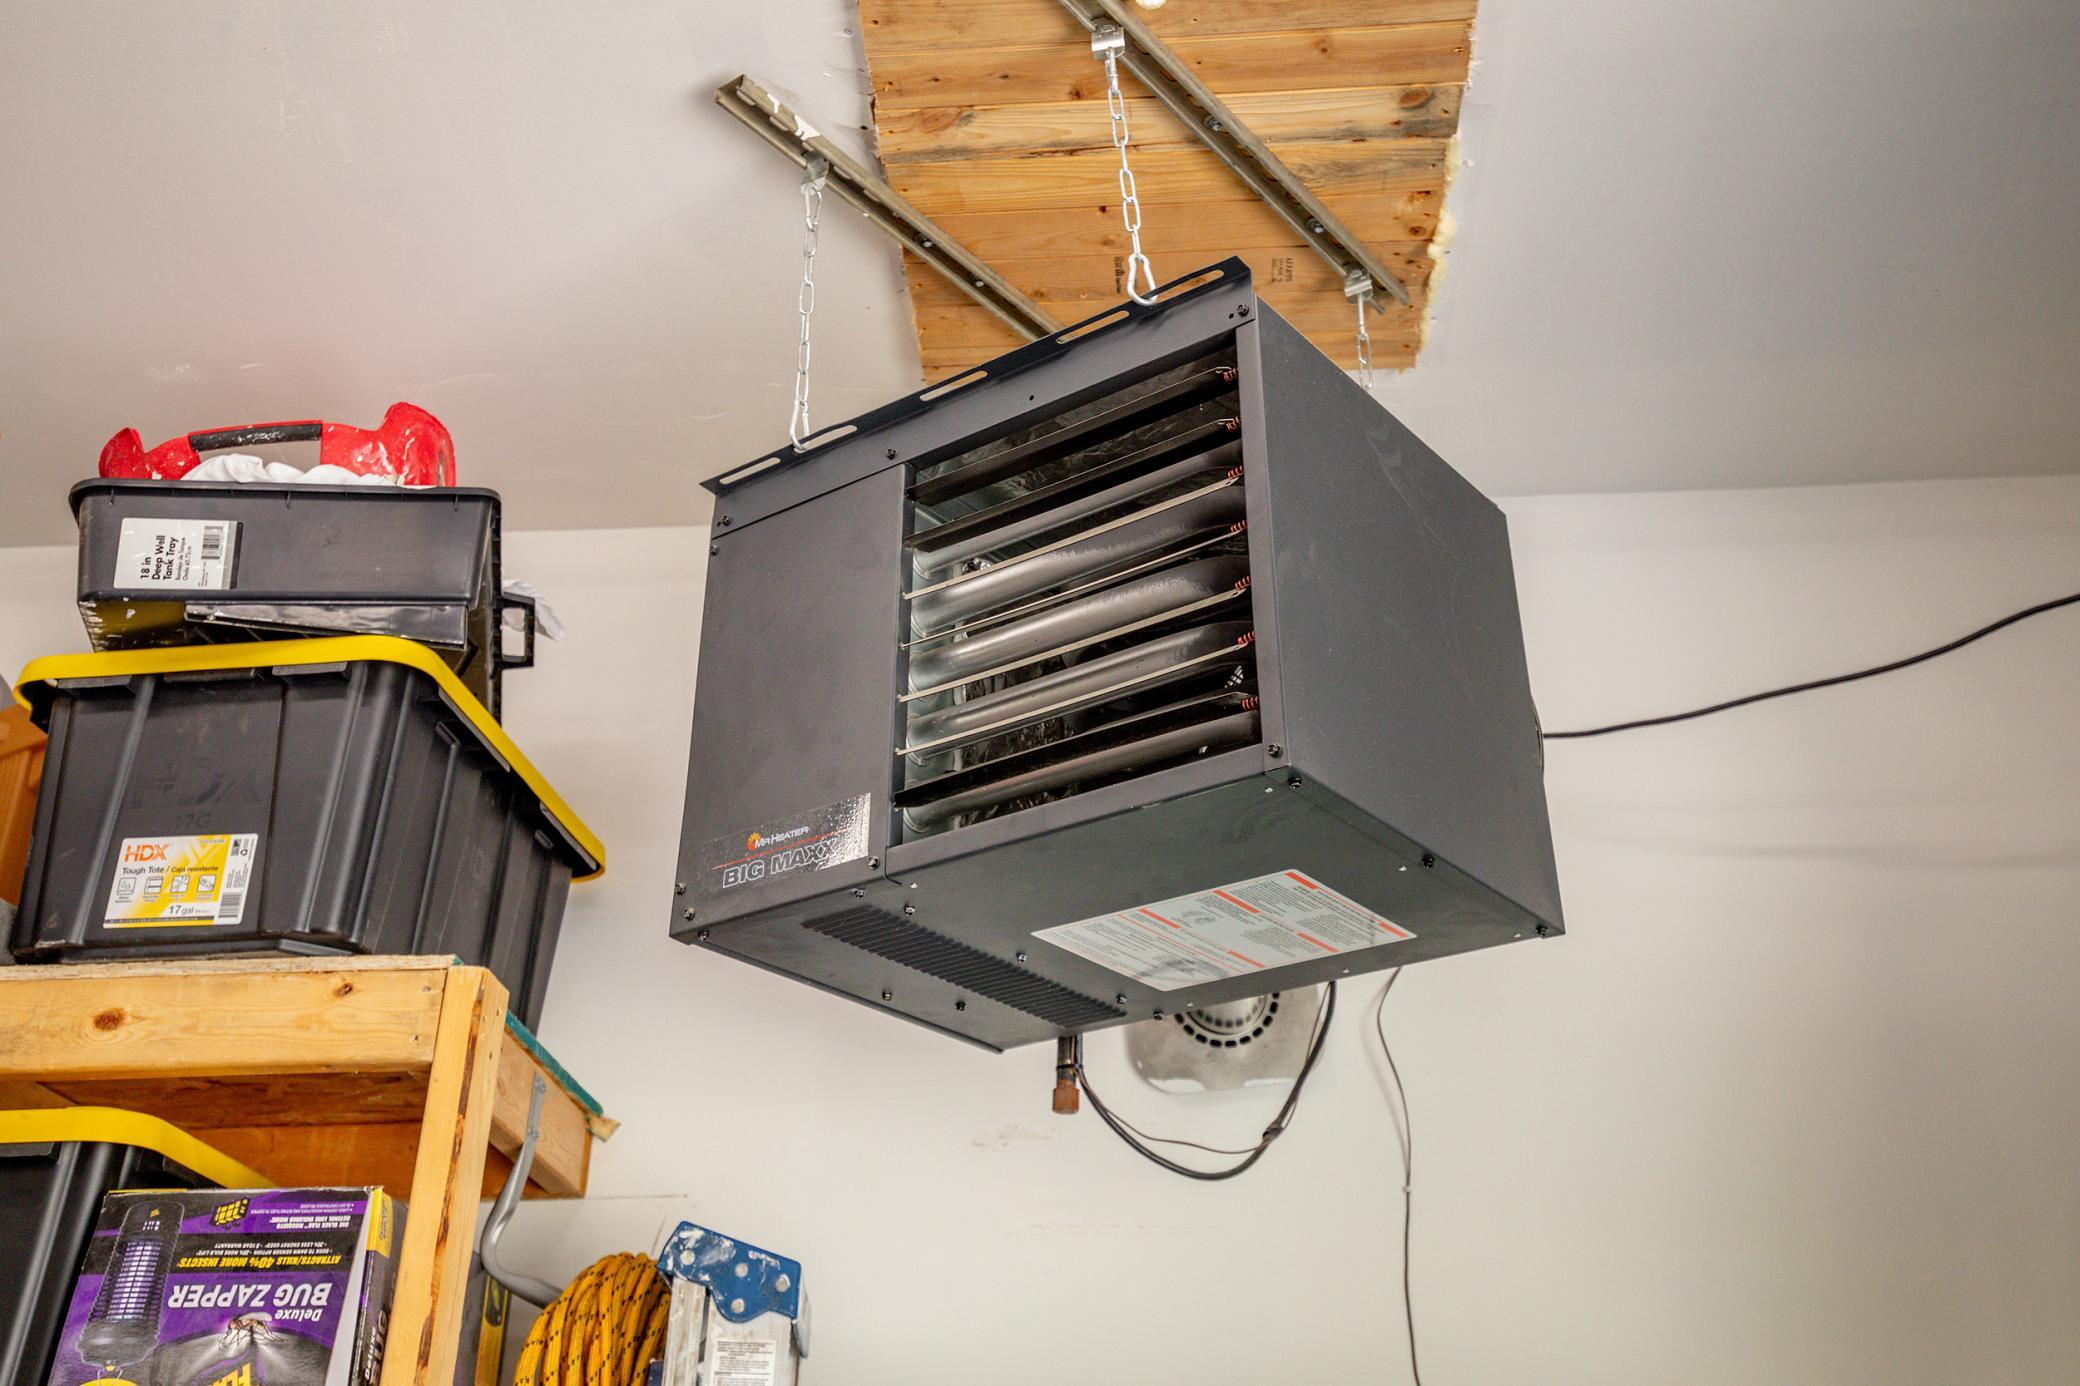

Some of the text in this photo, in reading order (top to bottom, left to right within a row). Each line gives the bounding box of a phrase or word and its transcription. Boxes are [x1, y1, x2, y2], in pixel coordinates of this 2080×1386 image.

[152, 535, 165, 580] Deep Well
[163, 537, 179, 580] Tank Tray
[141, 557, 151, 579] 18 in
[771, 826, 809, 845] HEATER
[124, 844, 170, 862] HDX
[123, 867, 146, 875] Tough
[722, 838, 838, 888] BIG MAXX
[169, 905, 182, 914] 17
[182, 907, 195, 916] gal
[219, 1257, 250, 1267] MORE
[249, 1256, 275, 1268] 40%
[276, 1255, 342, 1265] ATTRACTS/KILLS
[167, 1283, 333, 1308] BUG ZAPPER
[275, 1308, 323, 1322] Deluxe
[364, 1326, 376, 1380] Deluxe
[369, 1310, 388, 1385] BUG
